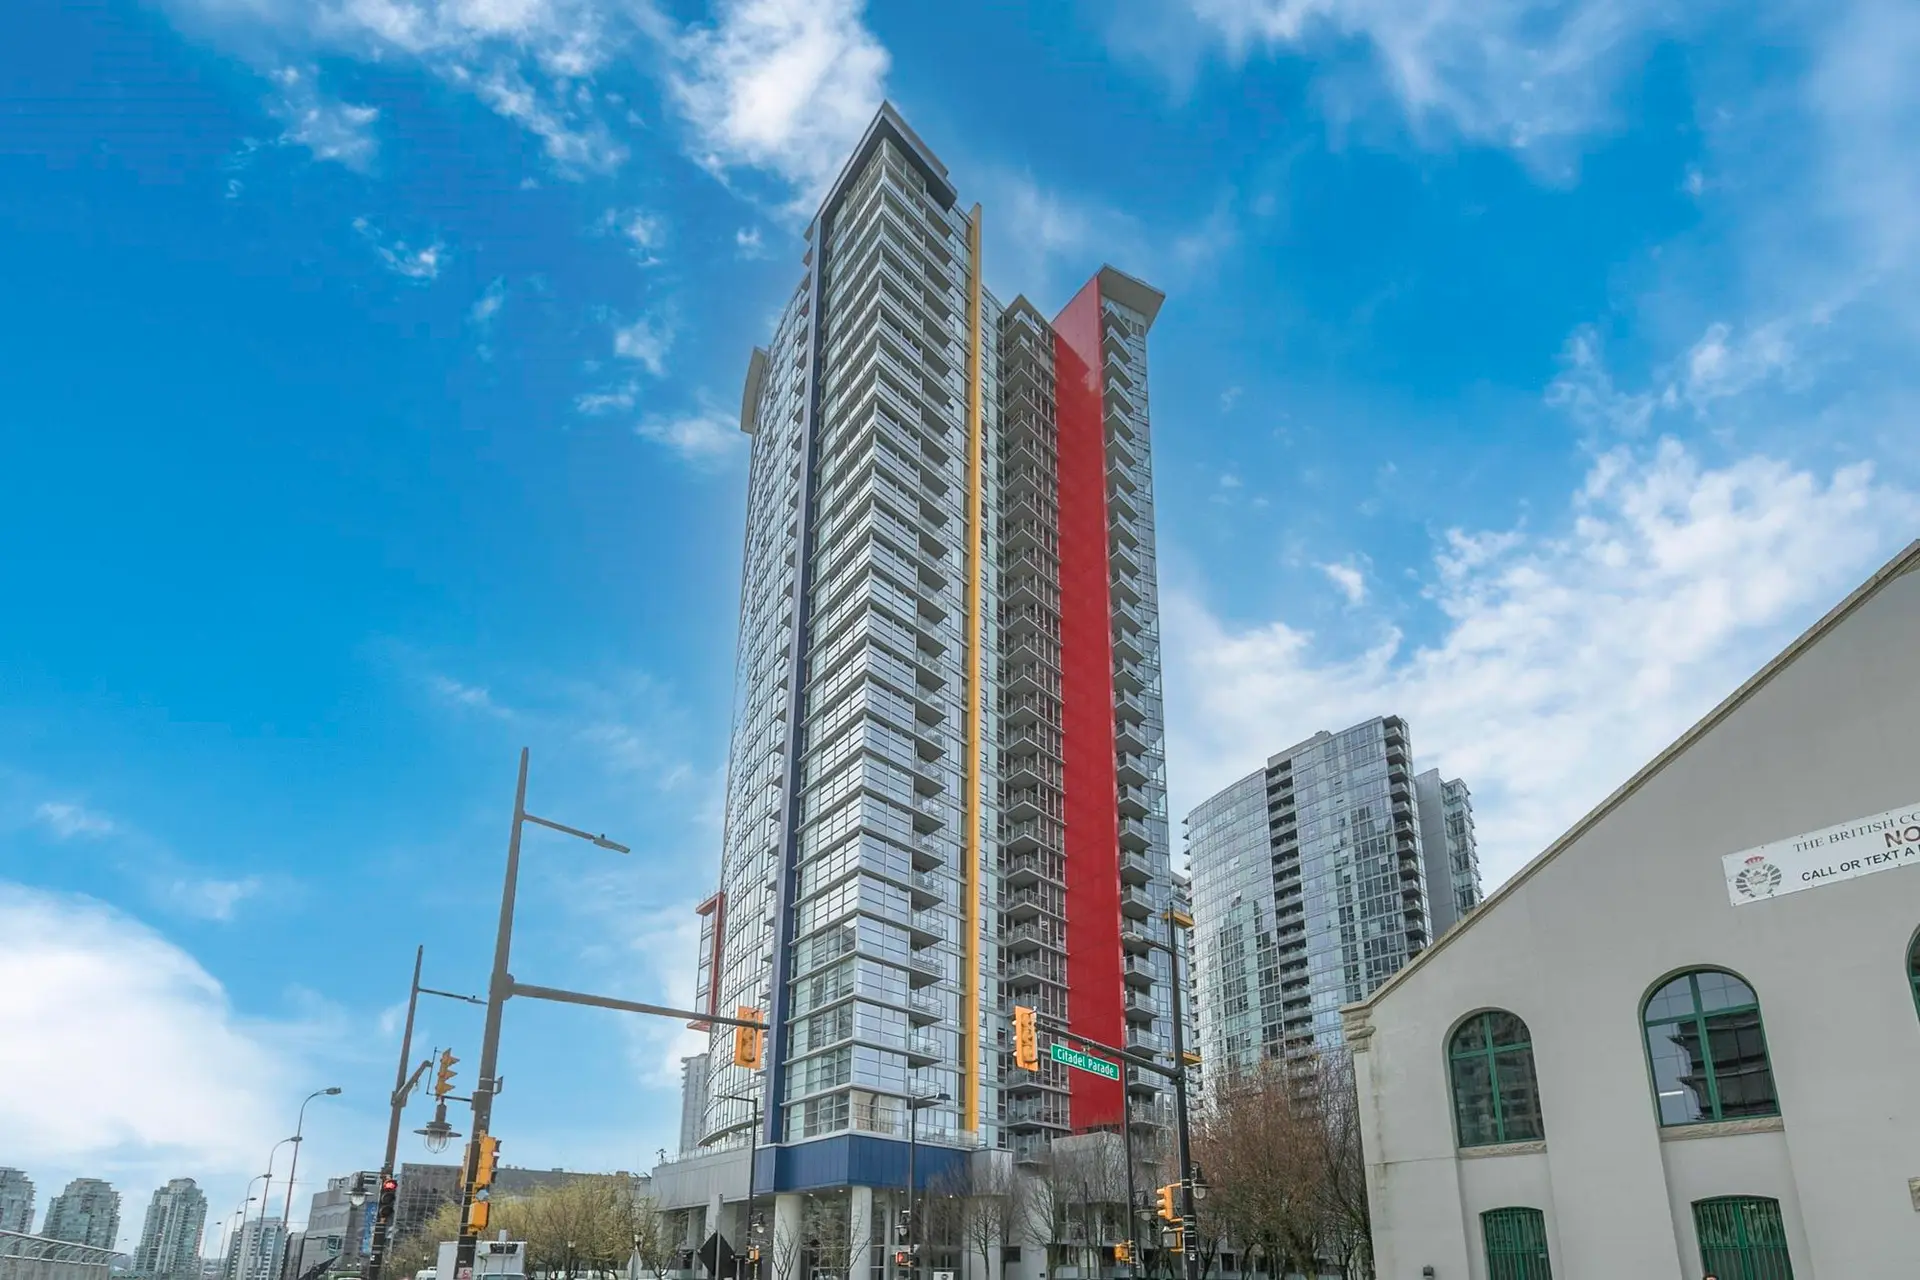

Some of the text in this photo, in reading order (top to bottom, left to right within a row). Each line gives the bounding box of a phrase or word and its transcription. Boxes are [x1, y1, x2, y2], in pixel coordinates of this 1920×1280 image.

[1793, 838, 1824, 852] THE
[1829, 819, 1894, 844] BRITISH
[1801, 866, 1837, 881] CALL
[1840, 860, 1861, 872] OR
[1864, 850, 1899, 865] TEXT
[1904, 847, 1915, 857] A
[1057, 1049, 1113, 1076] Citadel Parade
